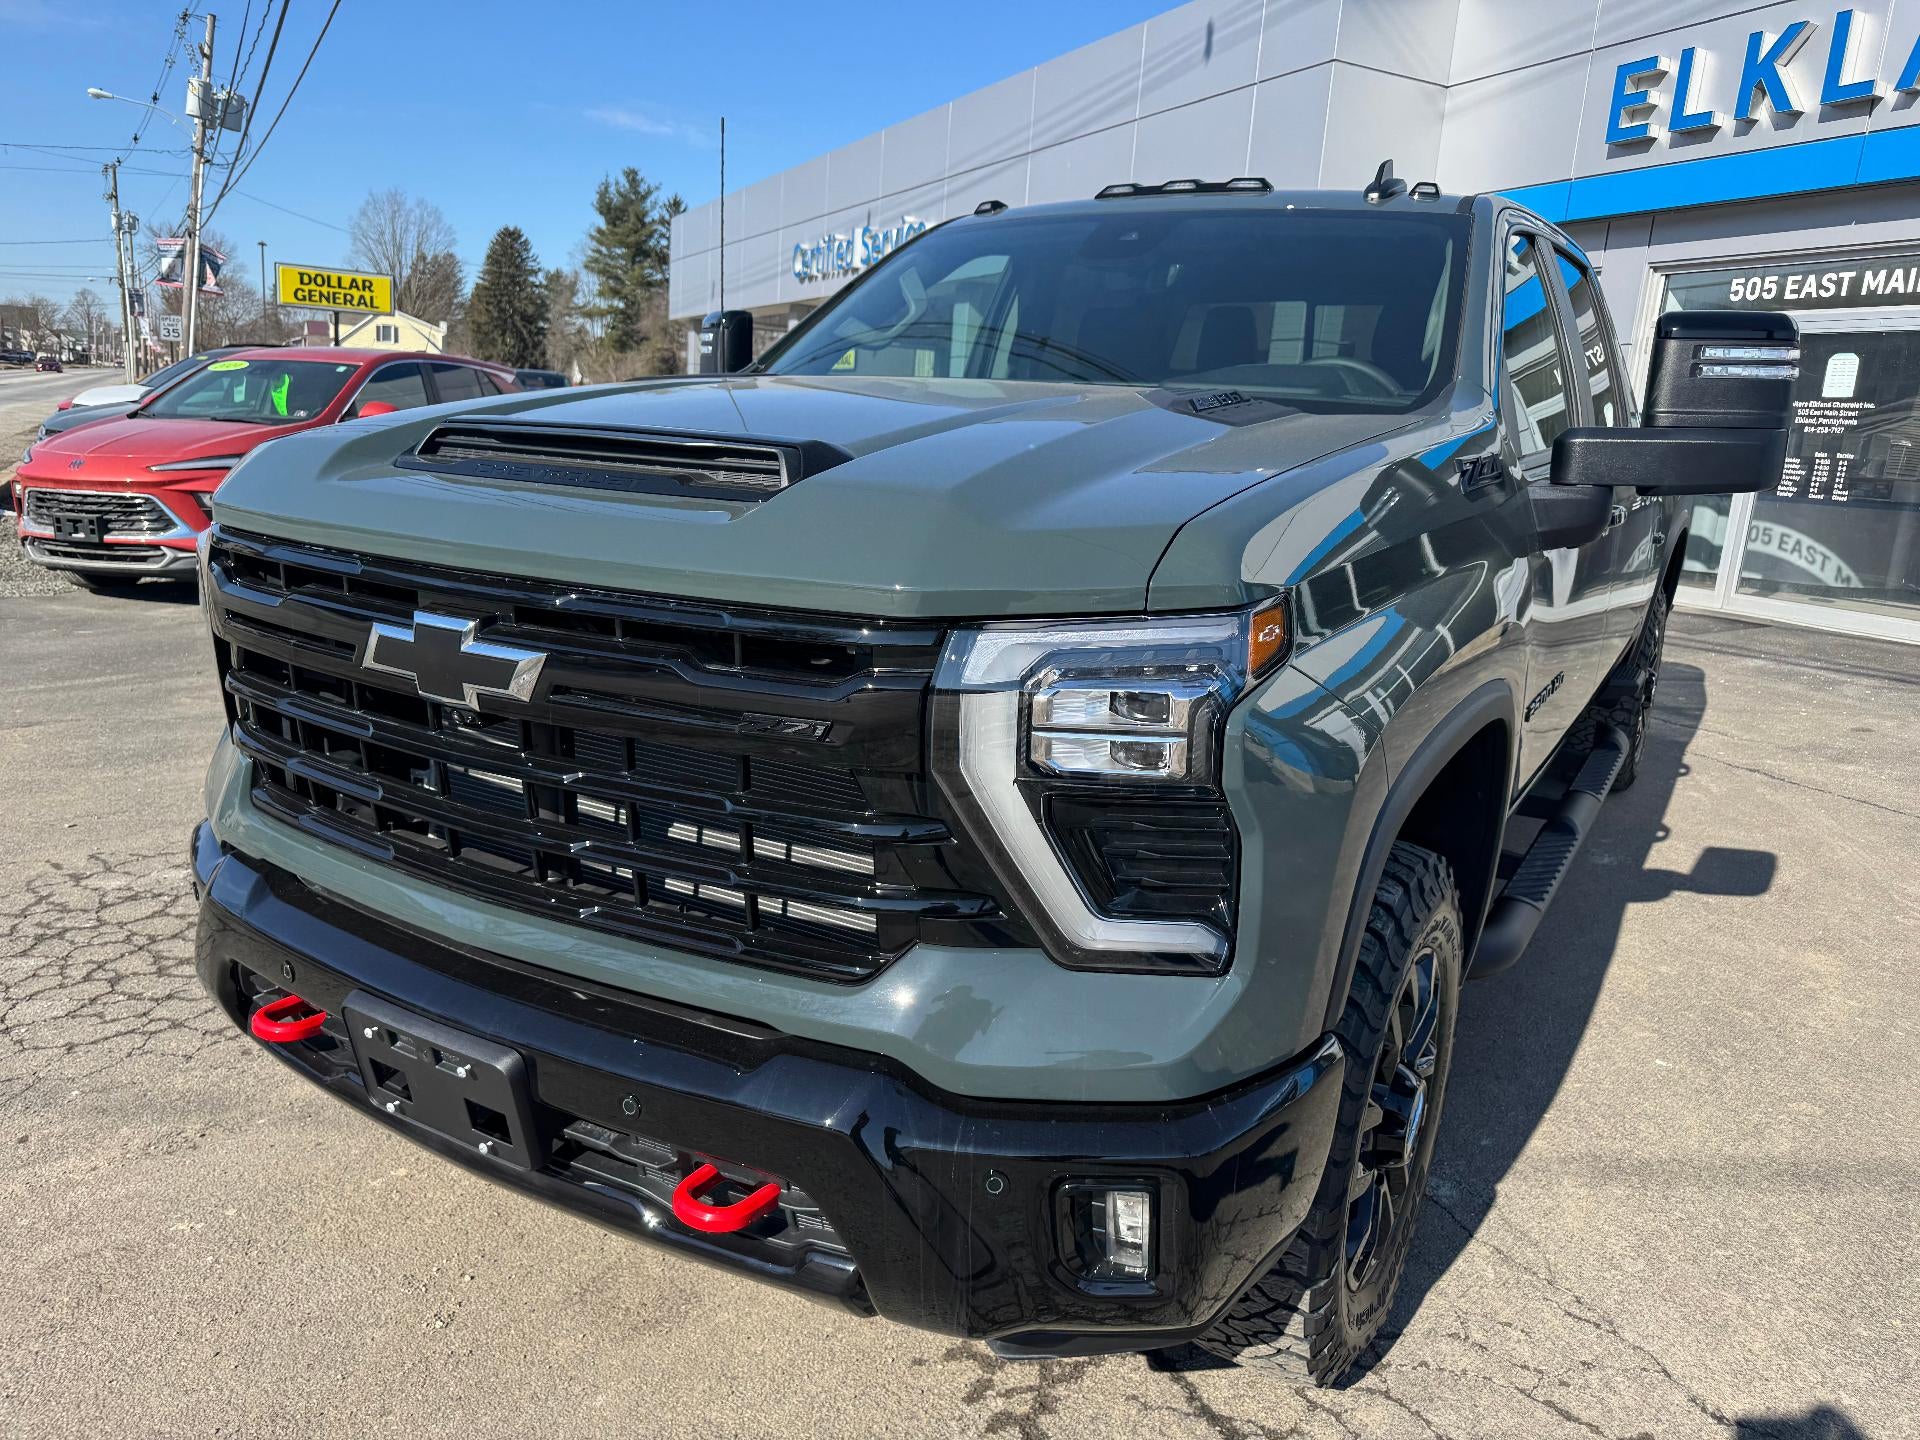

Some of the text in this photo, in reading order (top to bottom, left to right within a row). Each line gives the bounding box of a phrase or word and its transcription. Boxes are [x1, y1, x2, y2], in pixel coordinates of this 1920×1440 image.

[793, 229, 855, 279] Certified
[298, 271, 375, 293] DOLLAR
[1729, 267, 1920, 301] 505 EAST MAI
[293, 287, 380, 309] GENERAL
[163, 327, 180, 338] 35
[1777, 532, 1831, 572] EAST
